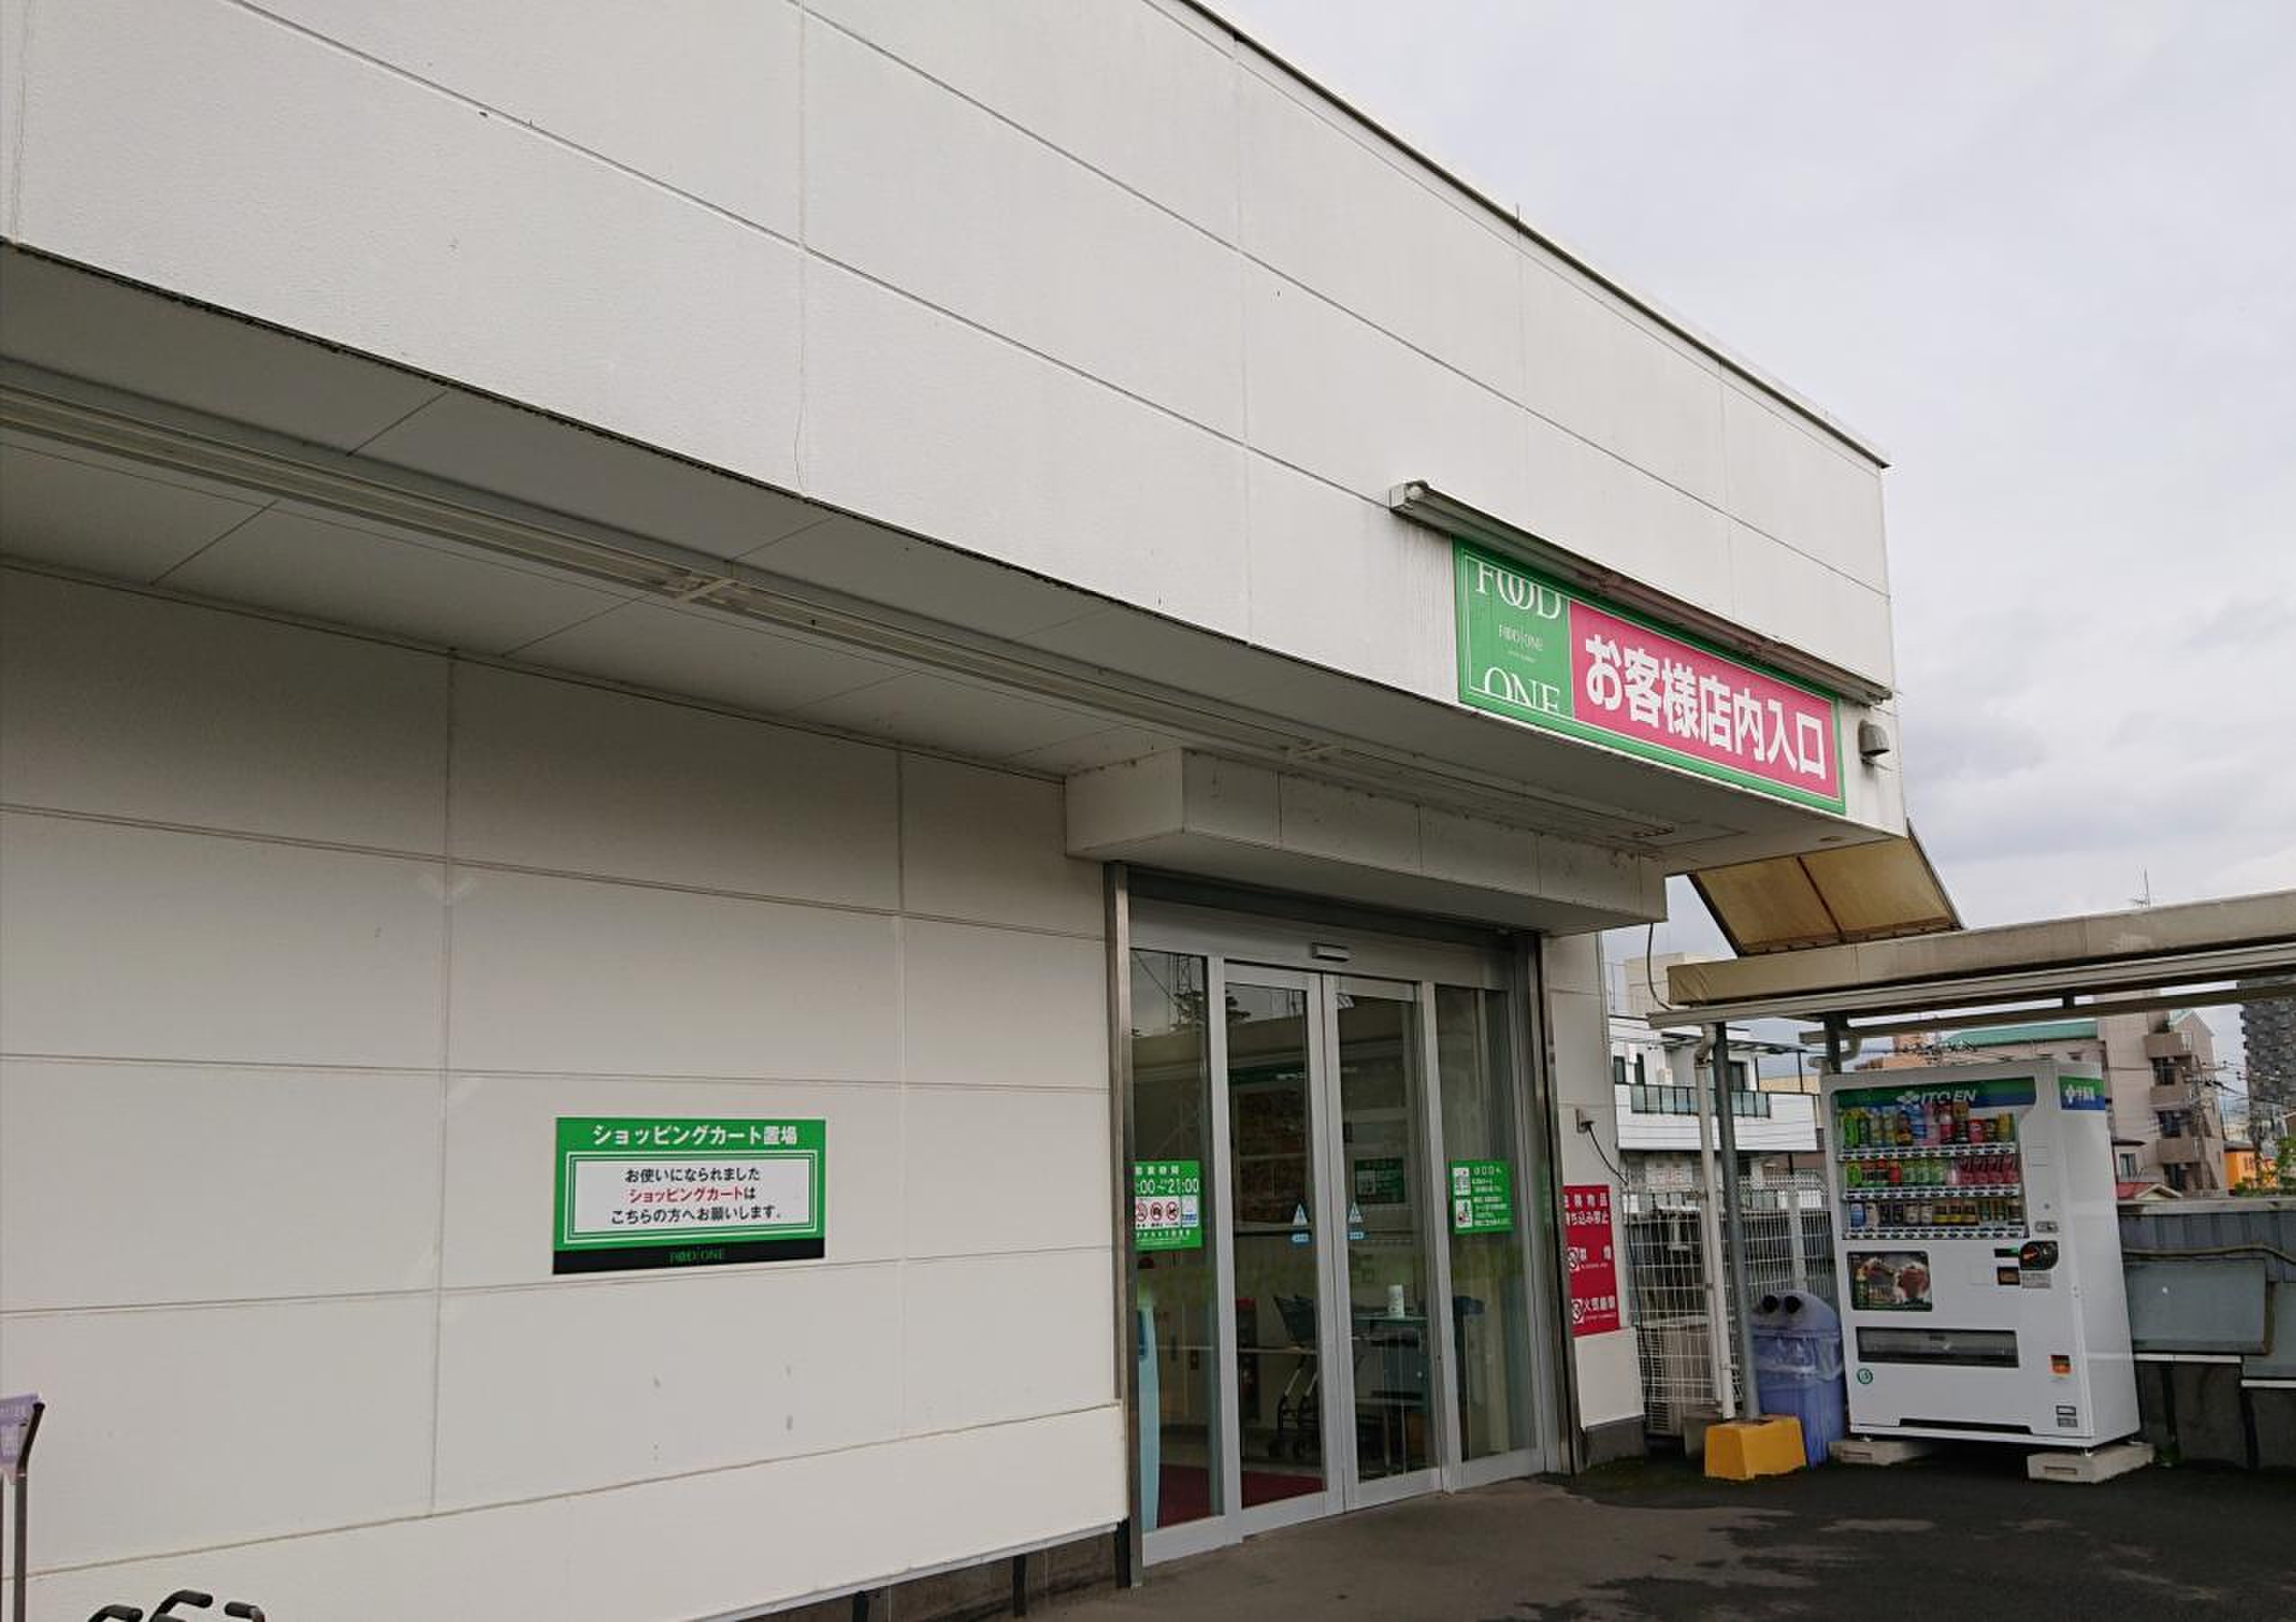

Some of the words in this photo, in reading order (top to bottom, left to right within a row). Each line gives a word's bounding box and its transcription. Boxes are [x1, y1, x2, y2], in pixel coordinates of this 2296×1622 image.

[1475, 561, 1561, 620] FOOD
[1484, 666, 1561, 713] ONE
[1585, 633, 1827, 780] お客様店内入口
[624, 1168, 761, 1183] お使いになられました
[628, 1186, 756, 1204] ショッピングカートは
